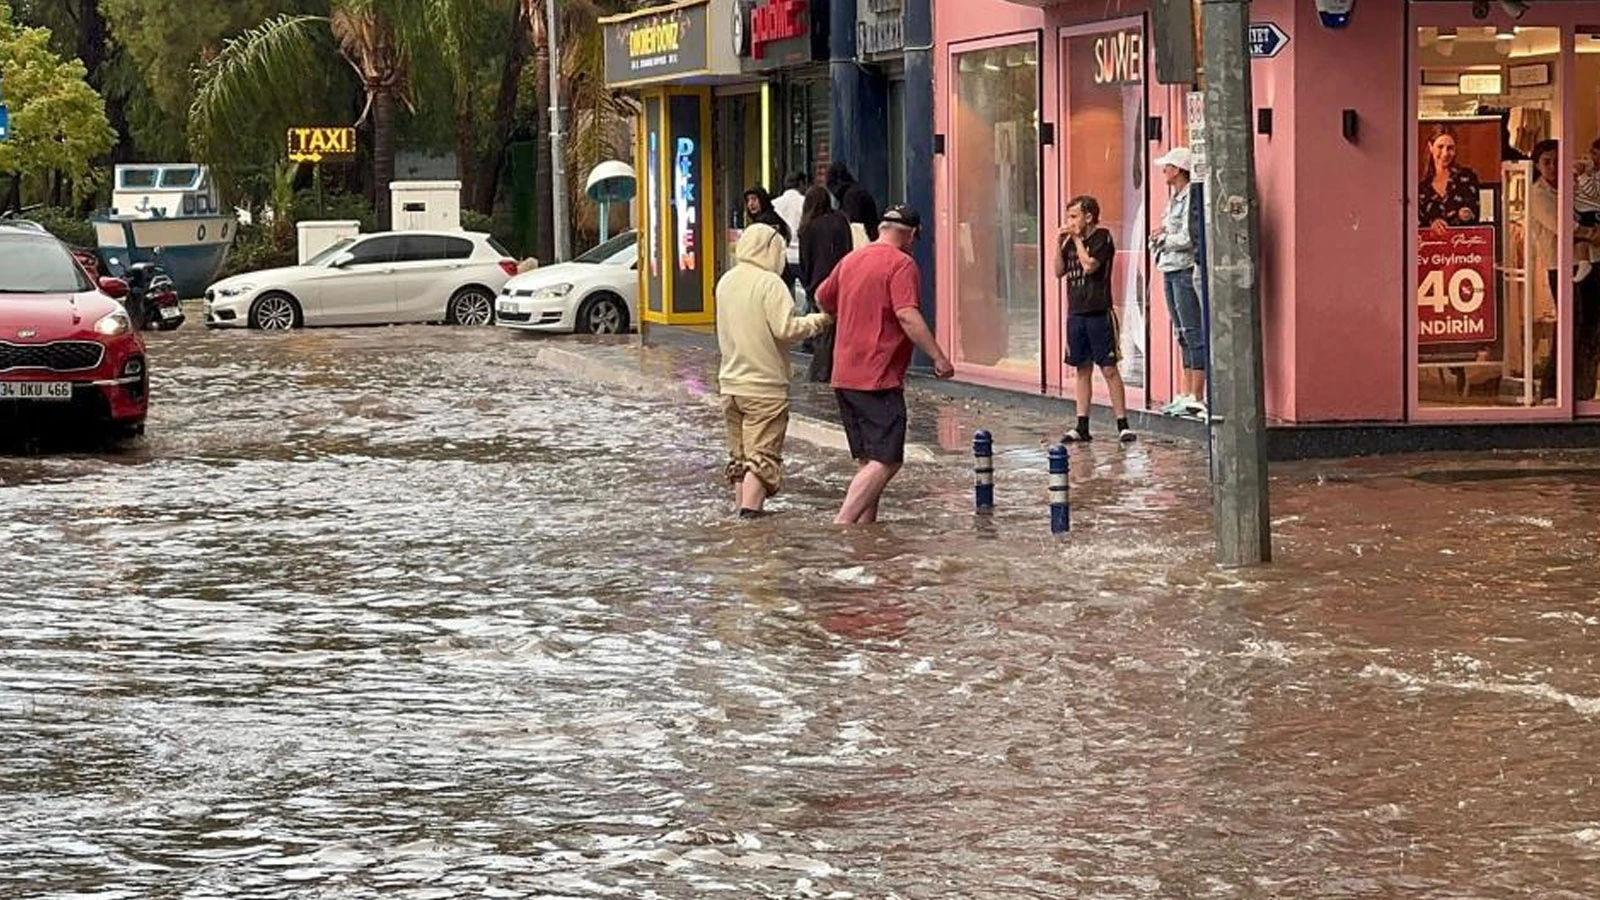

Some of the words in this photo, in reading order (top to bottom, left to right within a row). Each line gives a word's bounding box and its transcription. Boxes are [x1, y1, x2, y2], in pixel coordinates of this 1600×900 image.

[1095, 31, 1142, 84] SUWE
[295, 127, 347, 149] TAXI
[1418, 268, 1485, 313] 40
[1419, 315, 1484, 335] NDİRİM
[1, 383, 14, 396] 34
[48, 383, 69, 396] 466
